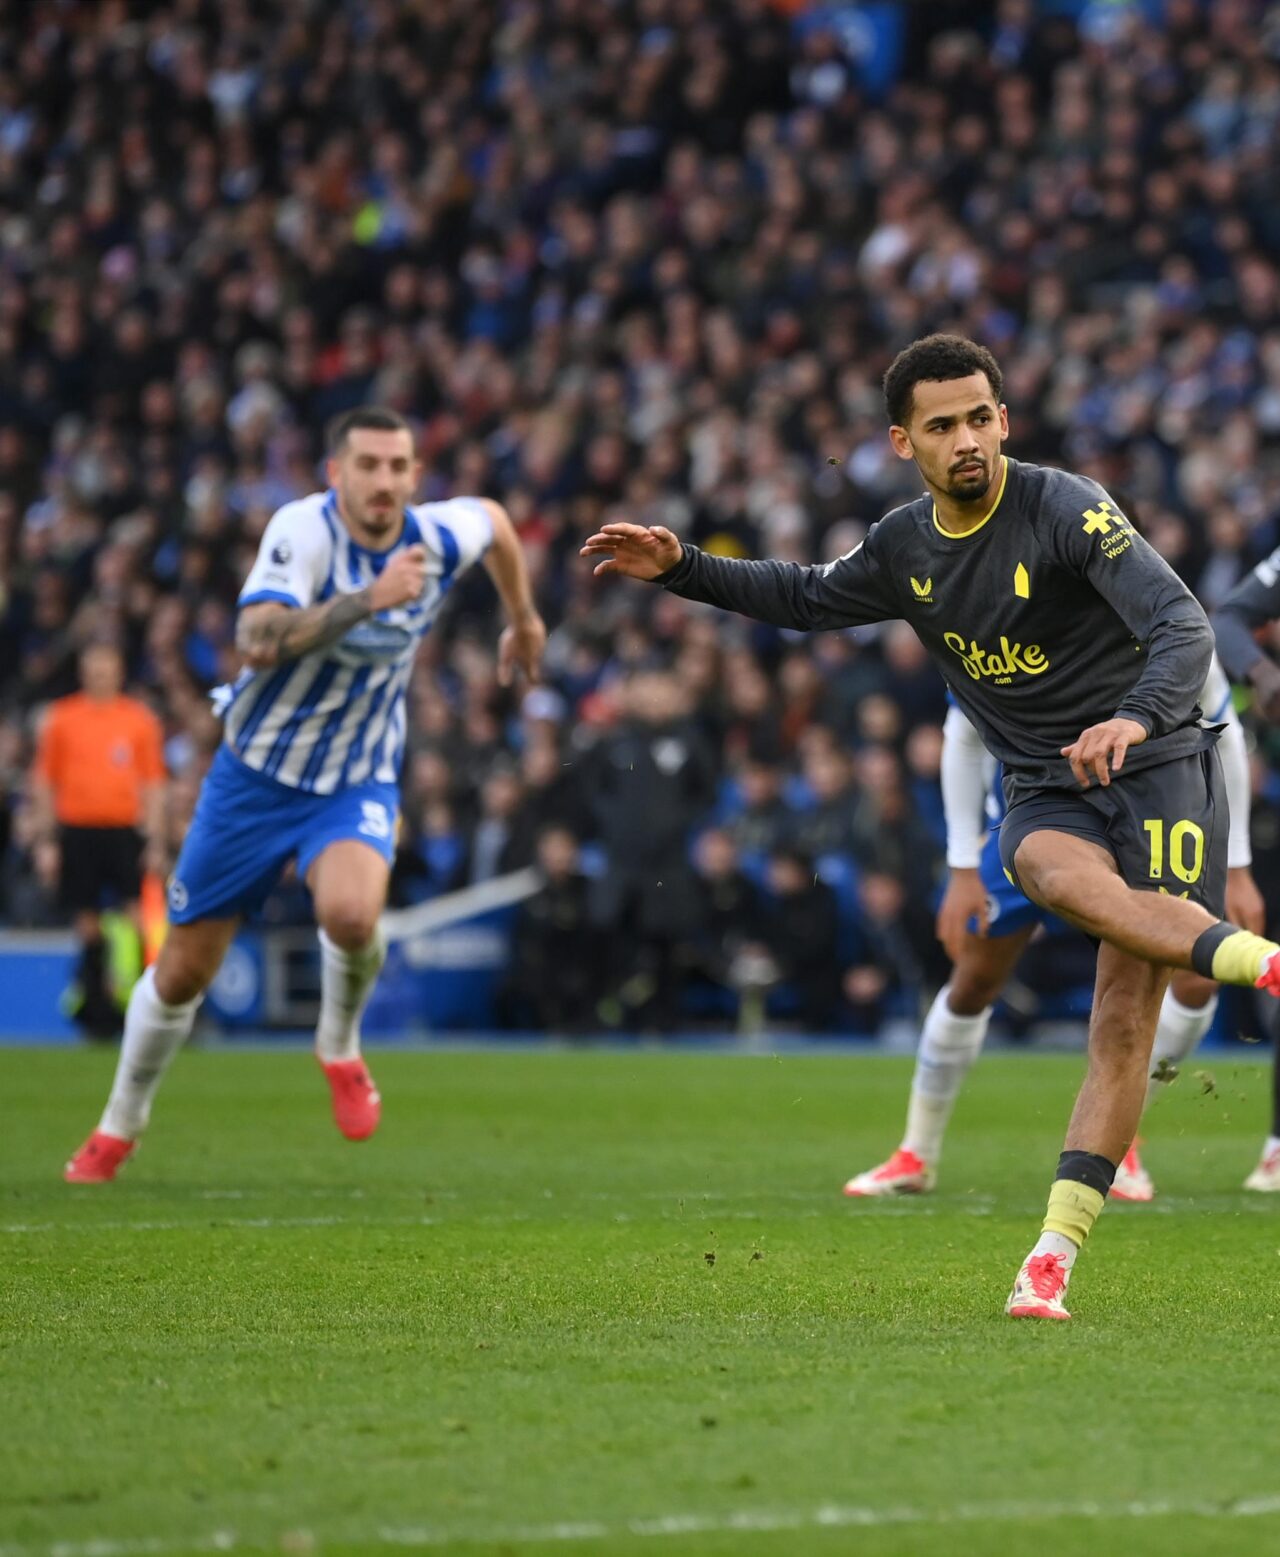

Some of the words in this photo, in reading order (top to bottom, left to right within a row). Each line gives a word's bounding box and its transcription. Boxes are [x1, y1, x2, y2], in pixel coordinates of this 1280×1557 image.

[1104, 538, 1131, 559] Ward
[943, 632, 1049, 680] Stake
[1143, 819, 1204, 883] 10
